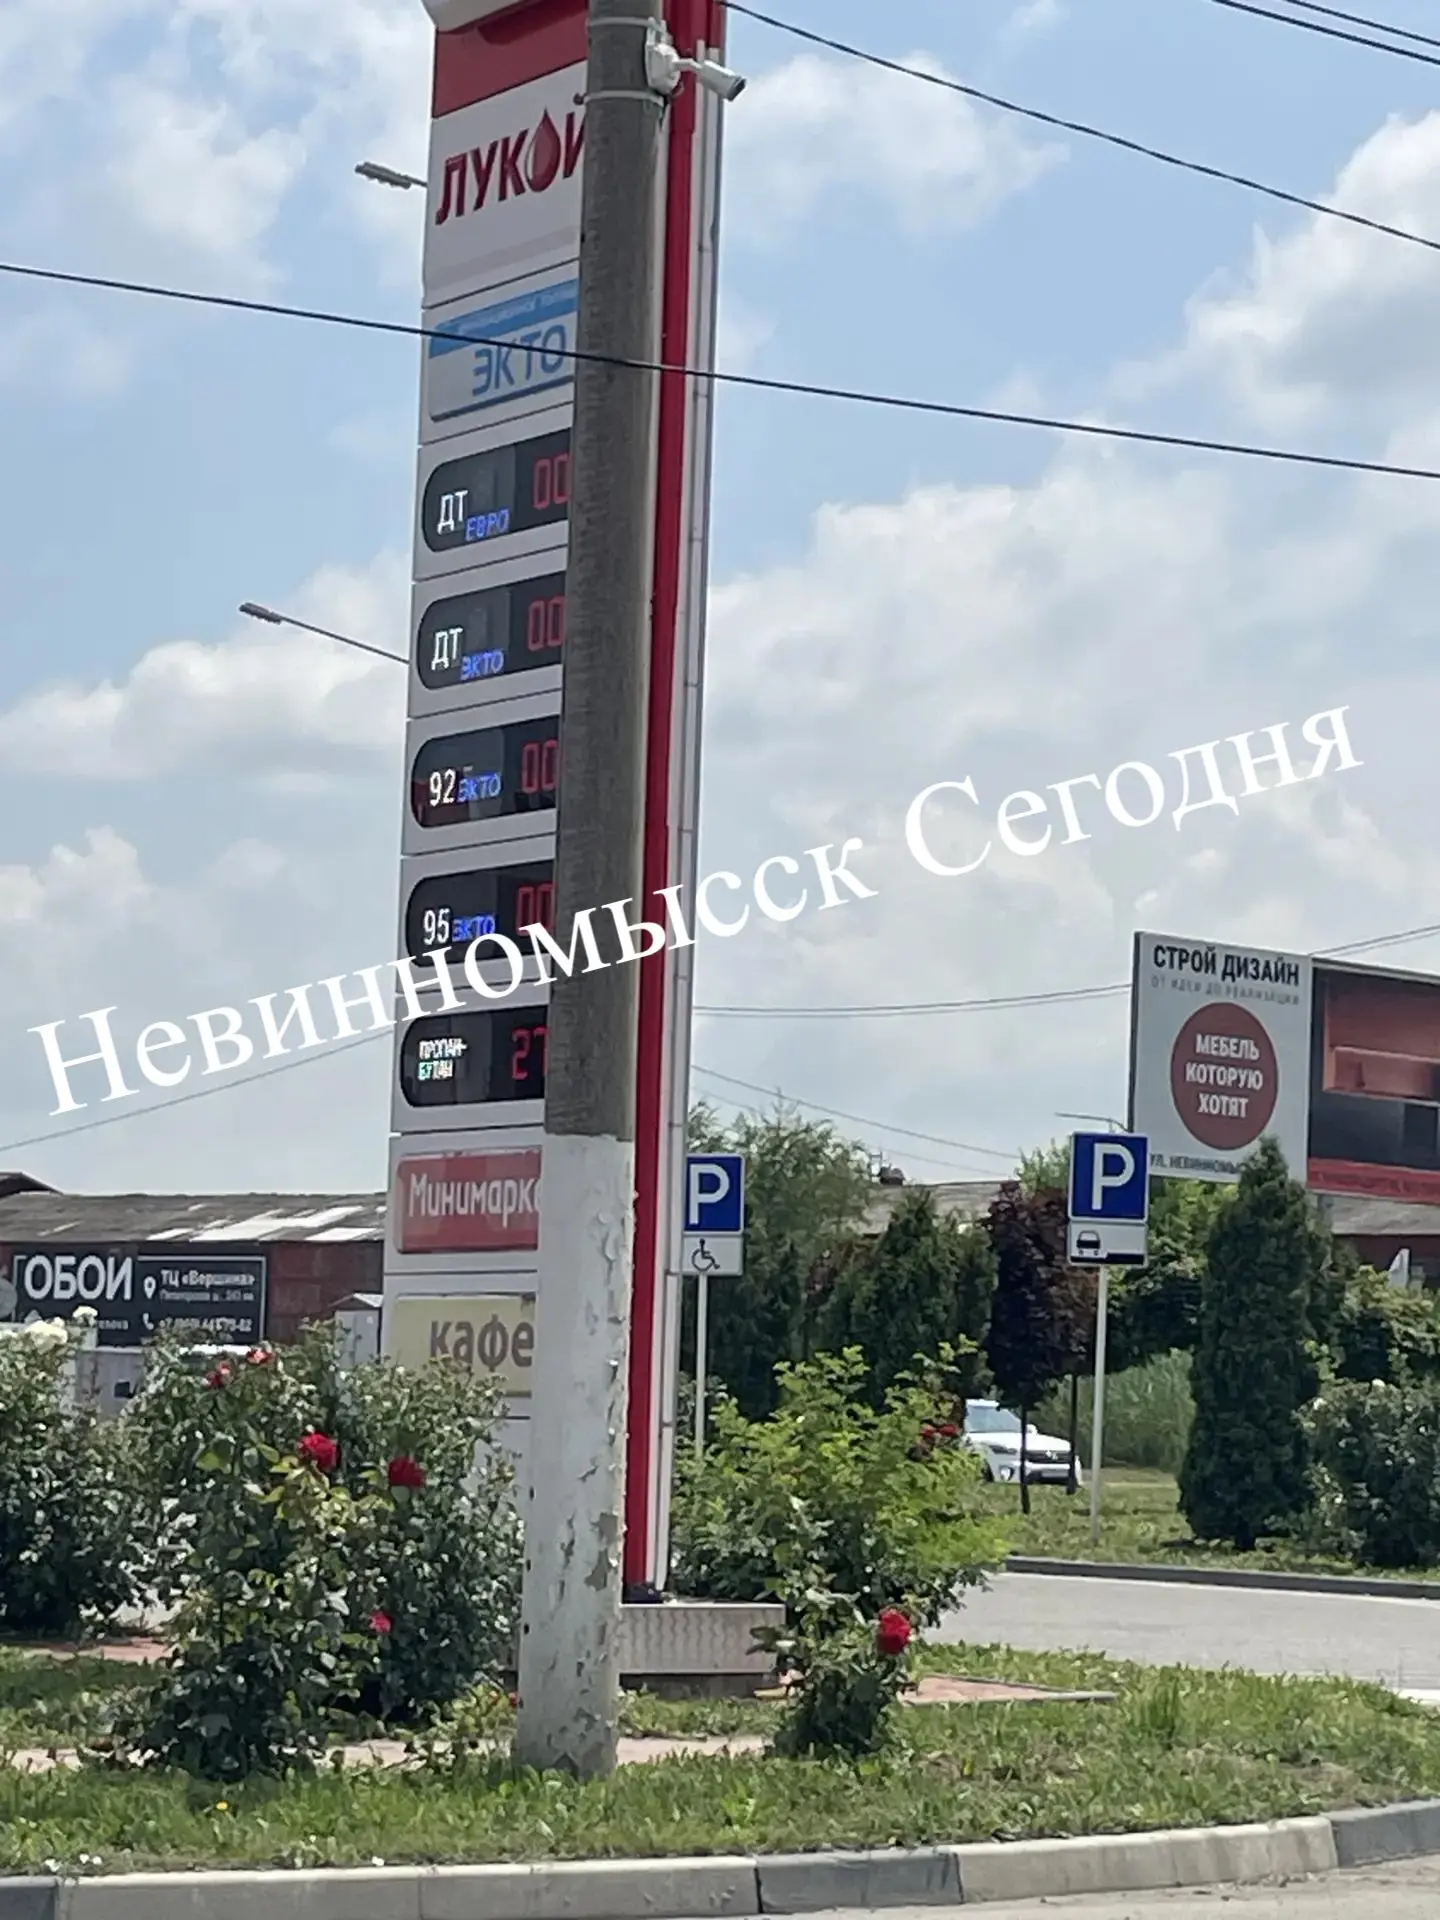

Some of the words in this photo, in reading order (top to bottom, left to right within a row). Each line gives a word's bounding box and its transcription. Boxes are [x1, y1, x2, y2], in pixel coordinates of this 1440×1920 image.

[472, 324, 567, 397] ЭКТО
[437, 490, 468, 535] ДТ
[465, 508, 510, 541] ЕВРО
[431, 627, 463, 670] ДТ
[460, 650, 505, 681] ЭКТО
[429, 768, 457, 807] 92
[457, 772, 502, 803] ЭКТО
[423, 908, 450, 945] 95
[452, 914, 497, 942] ЭКТО
[1152, 975, 1166, 989] ОТ
[1205, 982, 1222, 997] ДО
[1153, 945, 1217, 976] СТРОЙ
[1221, 954, 1300, 988] ДИЗАЙН
[1195, 1033, 1260, 1062] МЕБЕЛЬ
[1185, 1061, 1264, 1092] КОТОРУЮ
[1197, 1092, 1250, 1119] ХОТЯТ
[688, 1163, 730, 1224] P
[1091, 1142, 1136, 1211] P
[24, 1254, 133, 1300] ОБОИ
[160, 1268, 180, 1289] ТЦ
[430, 1314, 535, 1372] кафе
